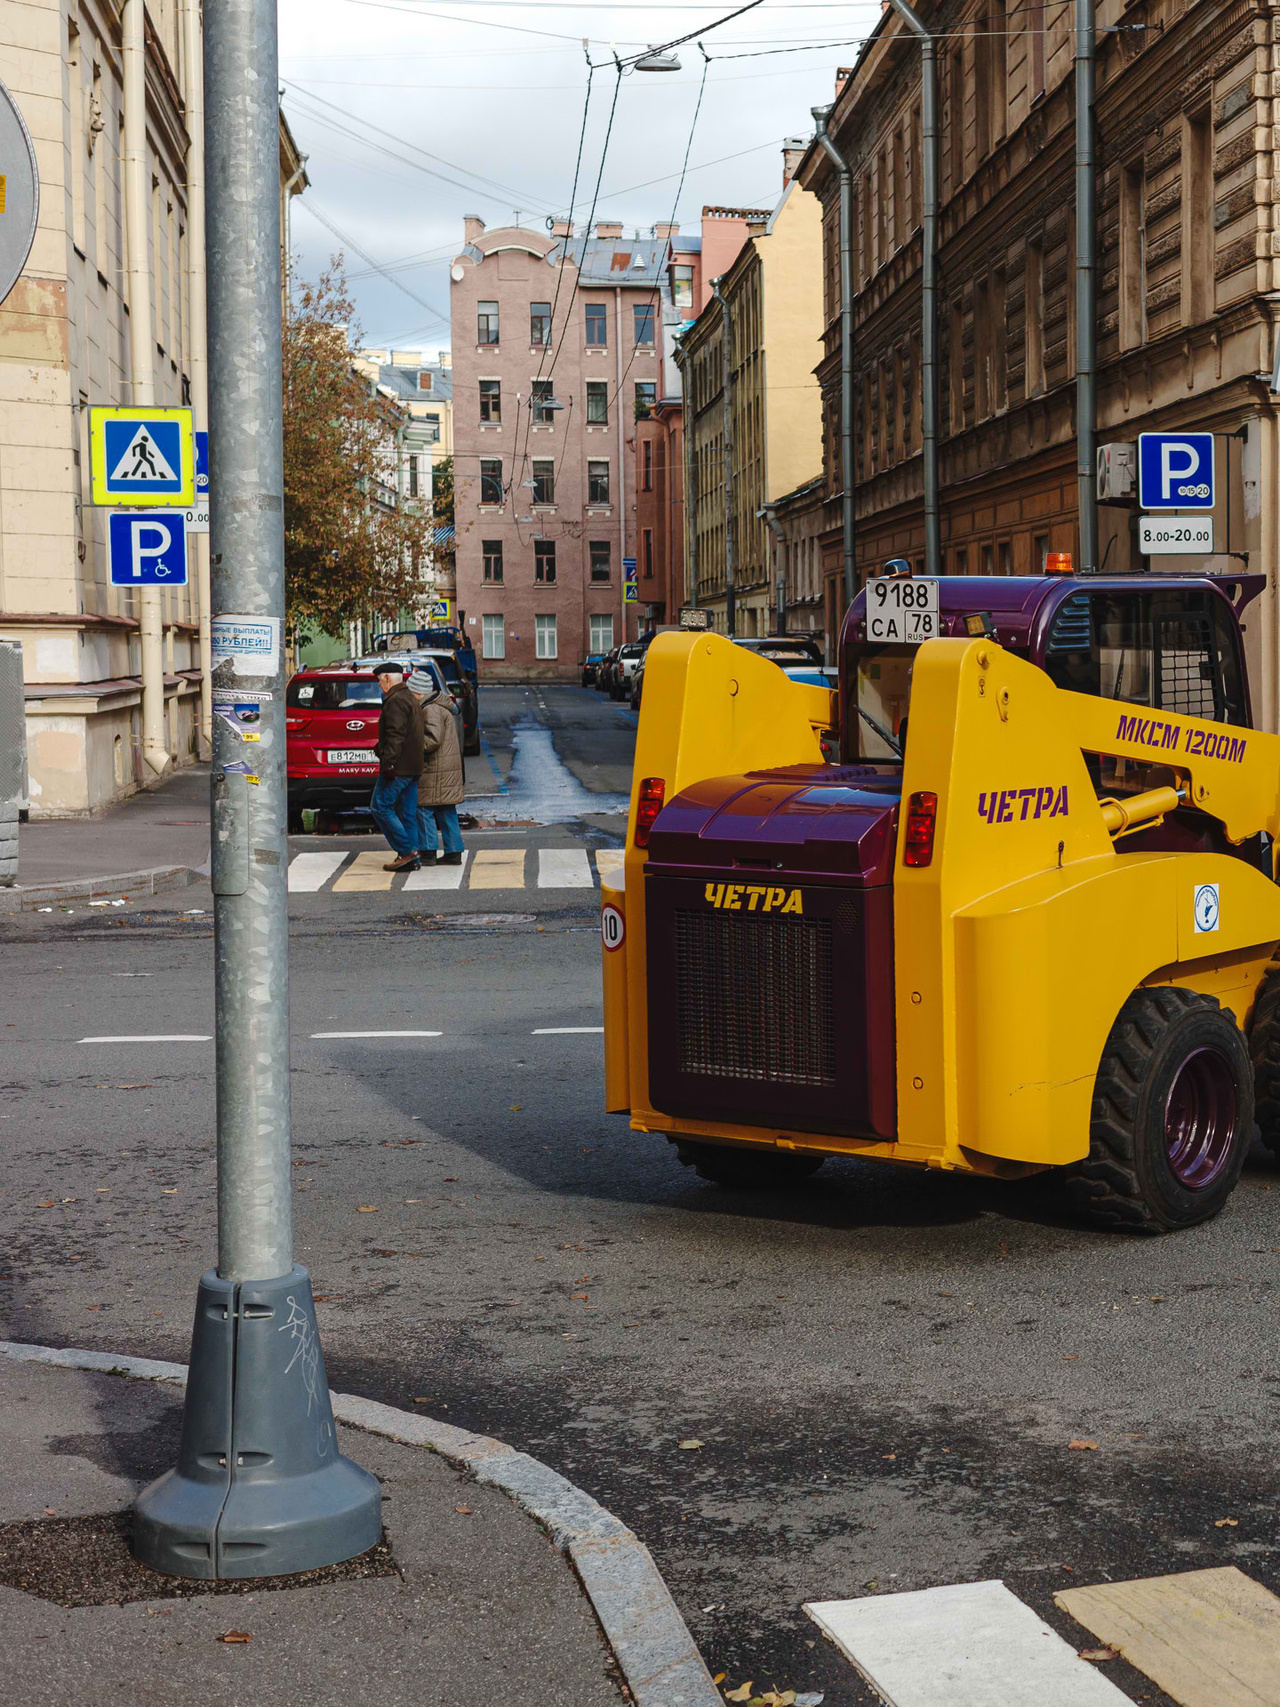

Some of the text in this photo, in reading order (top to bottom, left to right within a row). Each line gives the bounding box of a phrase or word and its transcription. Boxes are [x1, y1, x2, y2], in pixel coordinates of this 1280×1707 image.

[1161, 442, 1200, 499] P
[1198, 486, 1209, 495] 20
[130, 521, 172, 577] P
[1143, 529, 1210, 542] 8.00-20.00
[875, 583, 929, 608] 9188
[872, 613, 933, 638] СА 78
[907, 633, 924, 641] RUS
[1116, 715, 1247, 764] МКСМ 1200М
[978, 785, 1069, 824] ЧЕТРА
[704, 882, 804, 915] ЧЕТРА
[604, 914, 618, 942] 10
